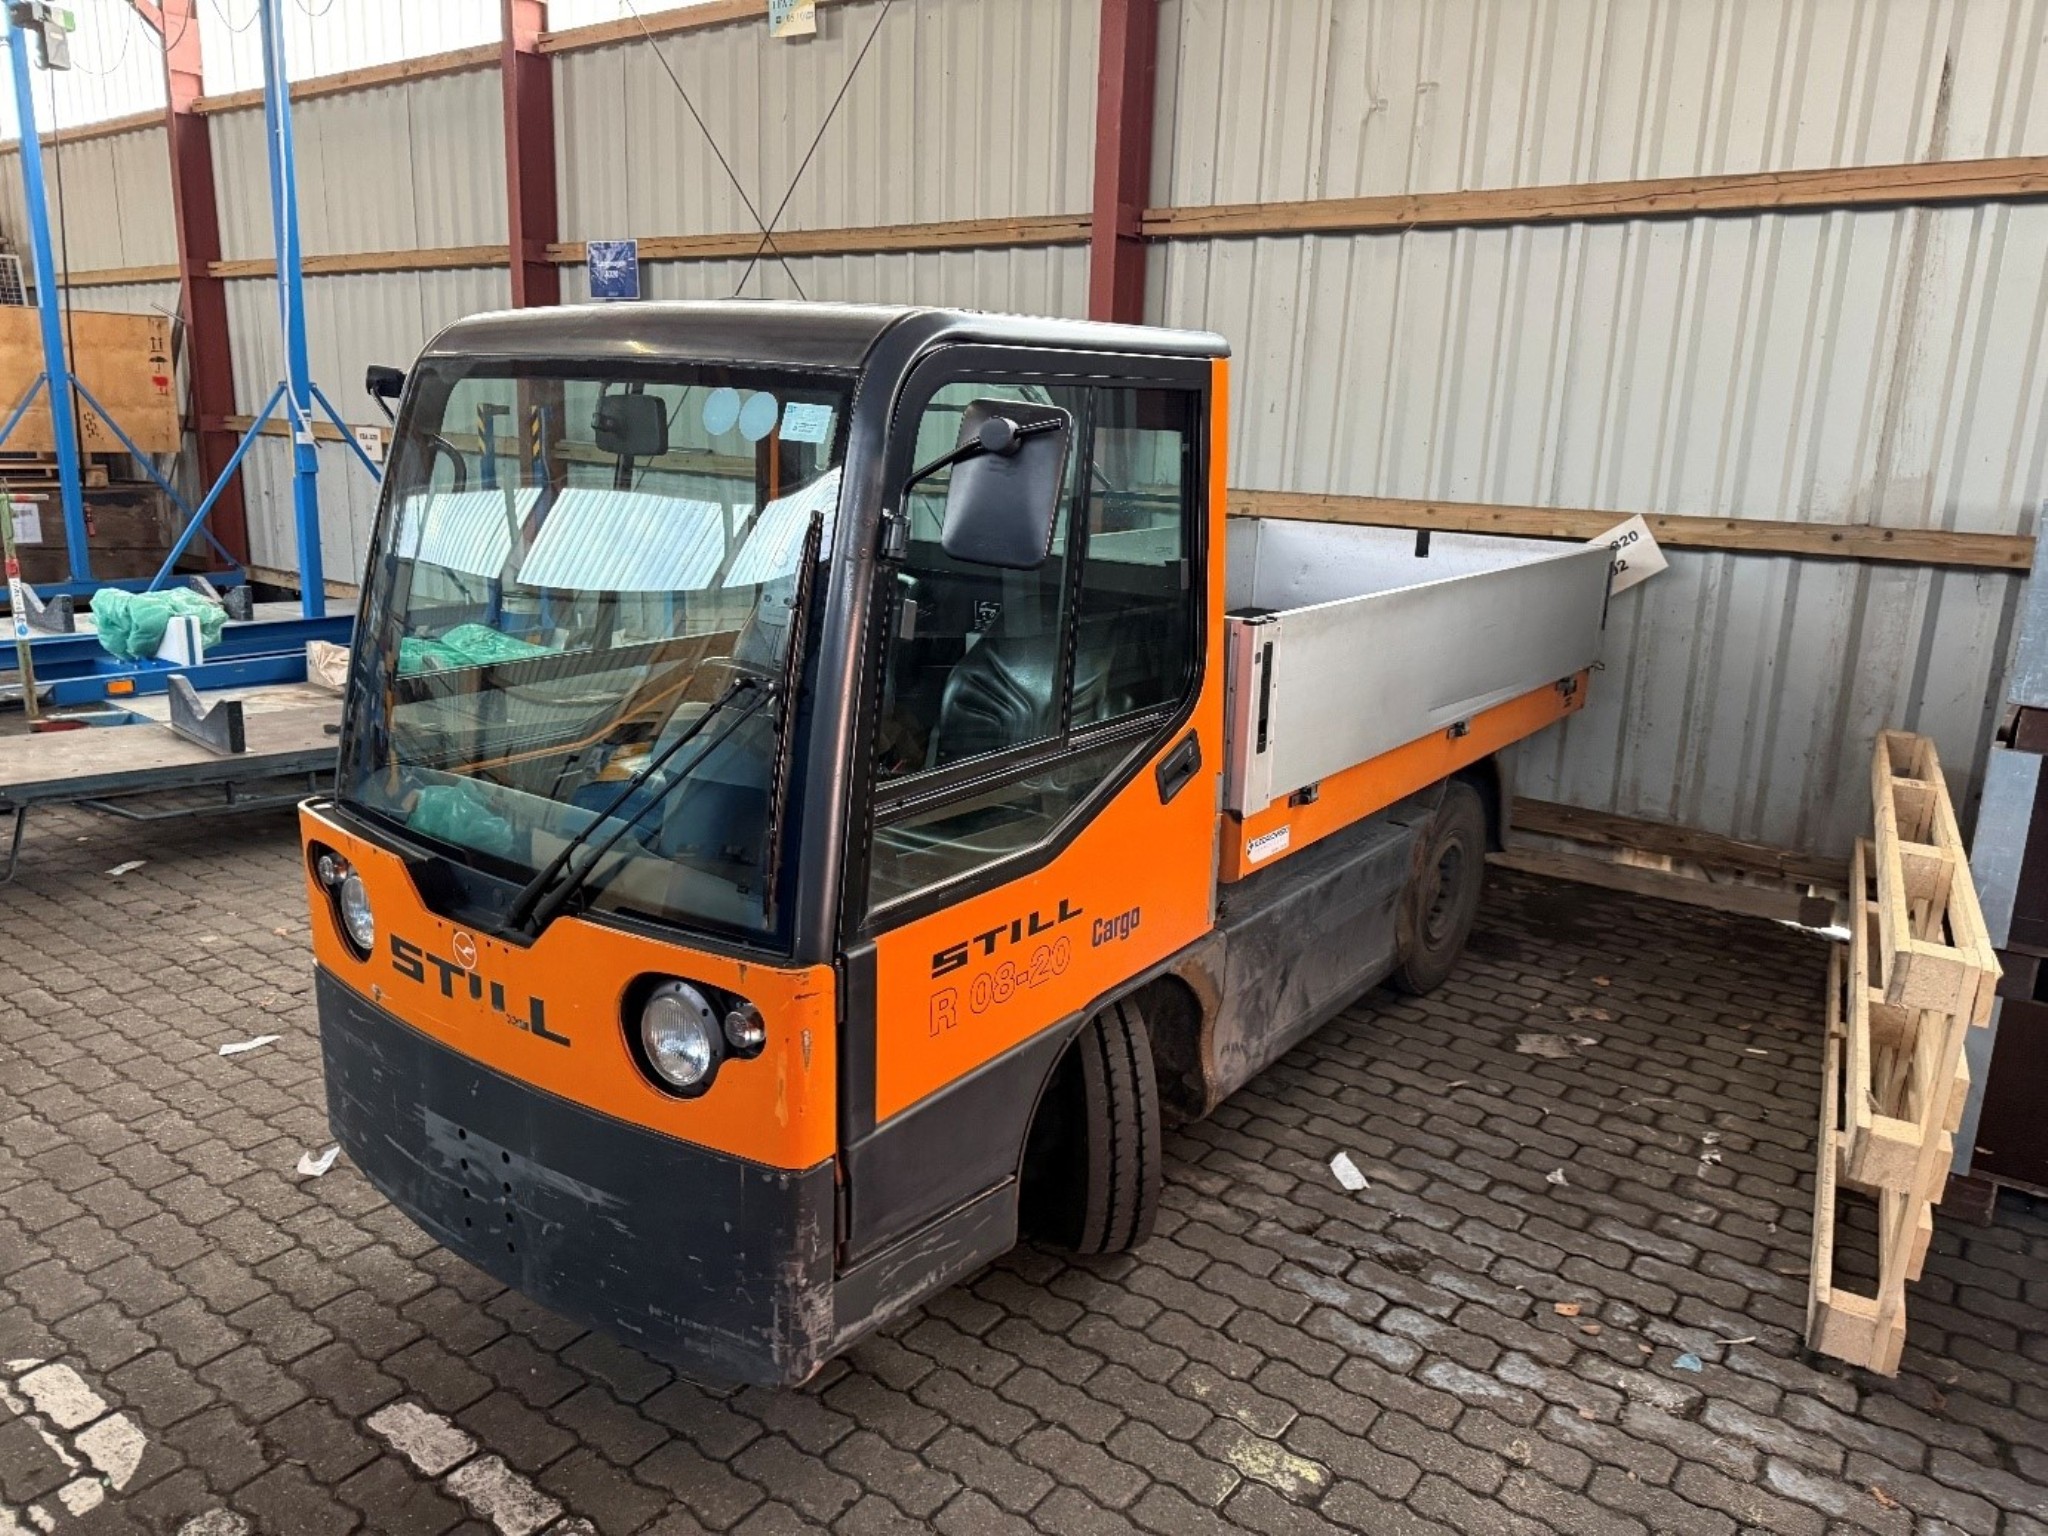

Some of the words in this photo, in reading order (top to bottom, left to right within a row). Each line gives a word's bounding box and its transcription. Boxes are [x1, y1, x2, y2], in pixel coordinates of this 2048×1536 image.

[931, 898, 1083, 979] STILL
[1092, 906, 1140, 948] Cargo
[390, 933, 571, 1048] STILL
[929, 987, 958, 1037] R
[969, 935, 1071, 1014] 08-20
